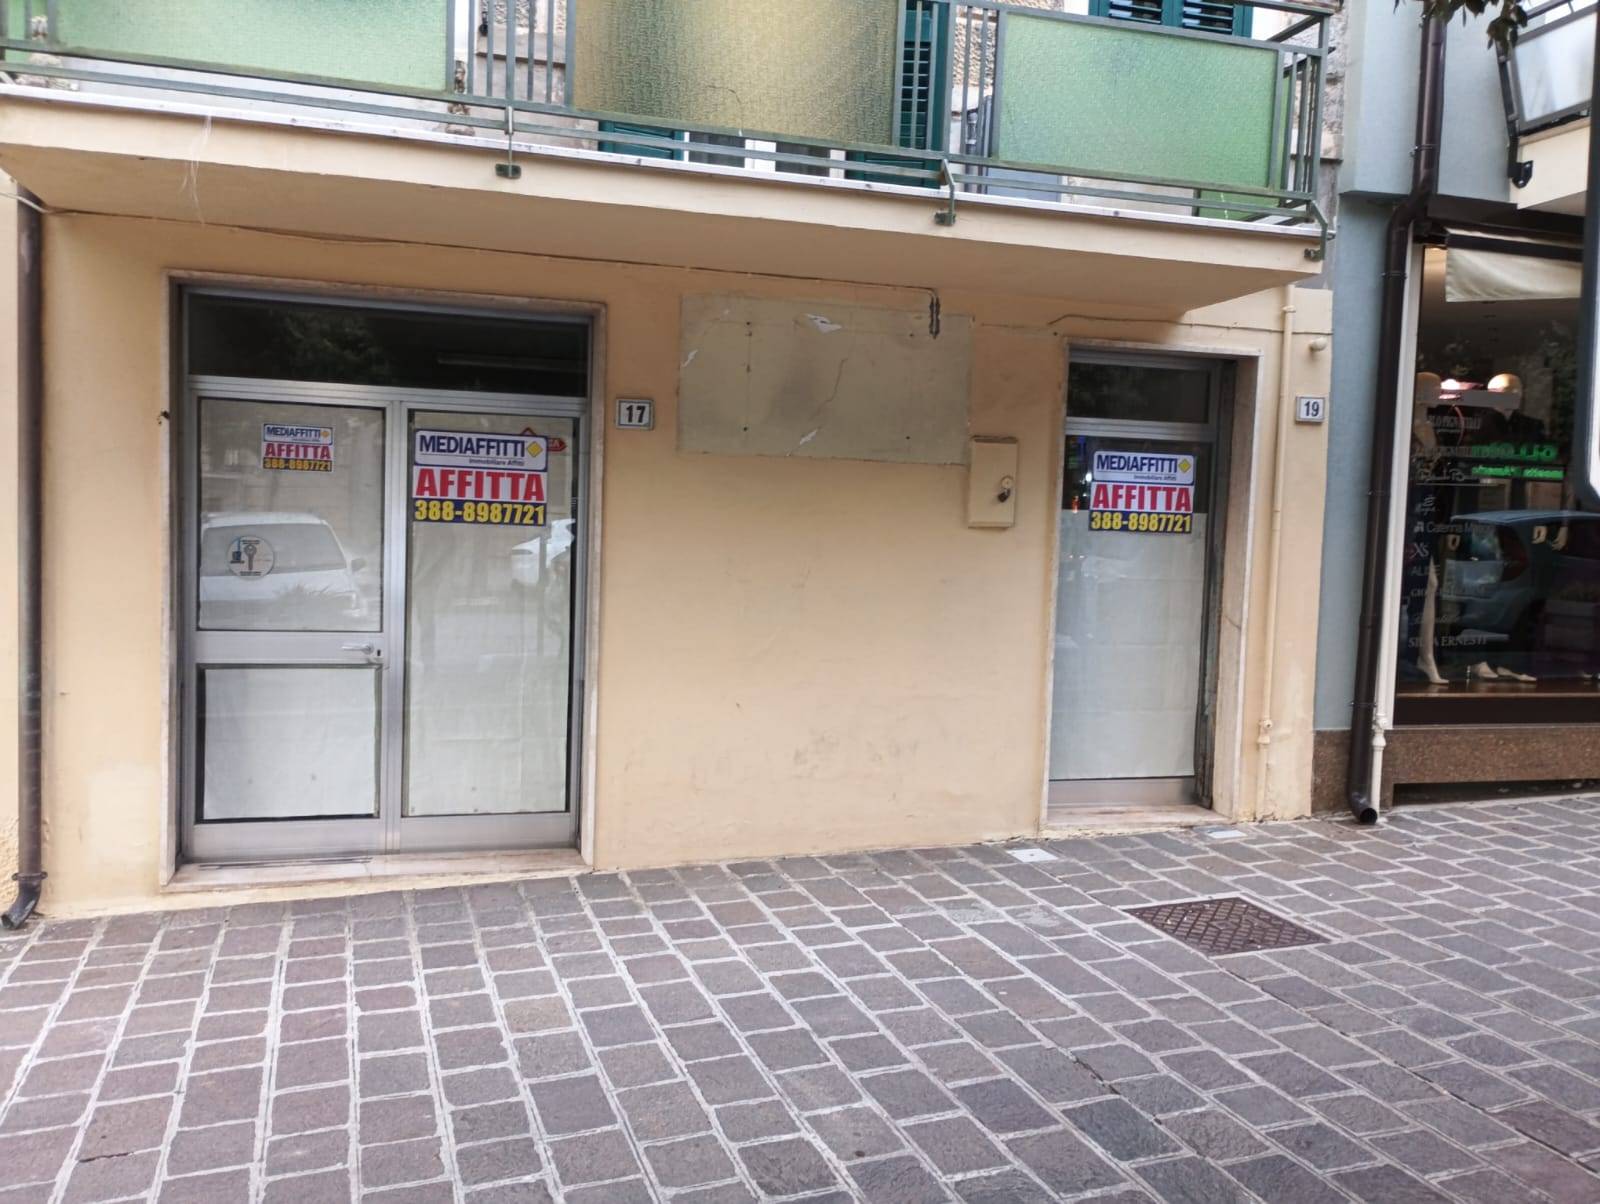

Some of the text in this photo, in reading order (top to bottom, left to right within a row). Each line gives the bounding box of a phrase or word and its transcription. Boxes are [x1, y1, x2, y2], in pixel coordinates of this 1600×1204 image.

[626, 404, 646, 424] 17
[1304, 400, 1320, 417] 19
[266, 426, 321, 440] MEDIAFFITTI
[264, 442, 332, 460] AFFITTA
[418, 434, 525, 457] MEDIAFFITTI
[468, 458, 506, 466] Immobiliare
[1096, 454, 1178, 473] MEDIAFFITTI
[415, 468, 544, 502] AFFITTA
[1092, 483, 1191, 512] AFFITTA
[414, 500, 545, 526] 388-8987721
[1091, 511, 1192, 533] 388-8987721
